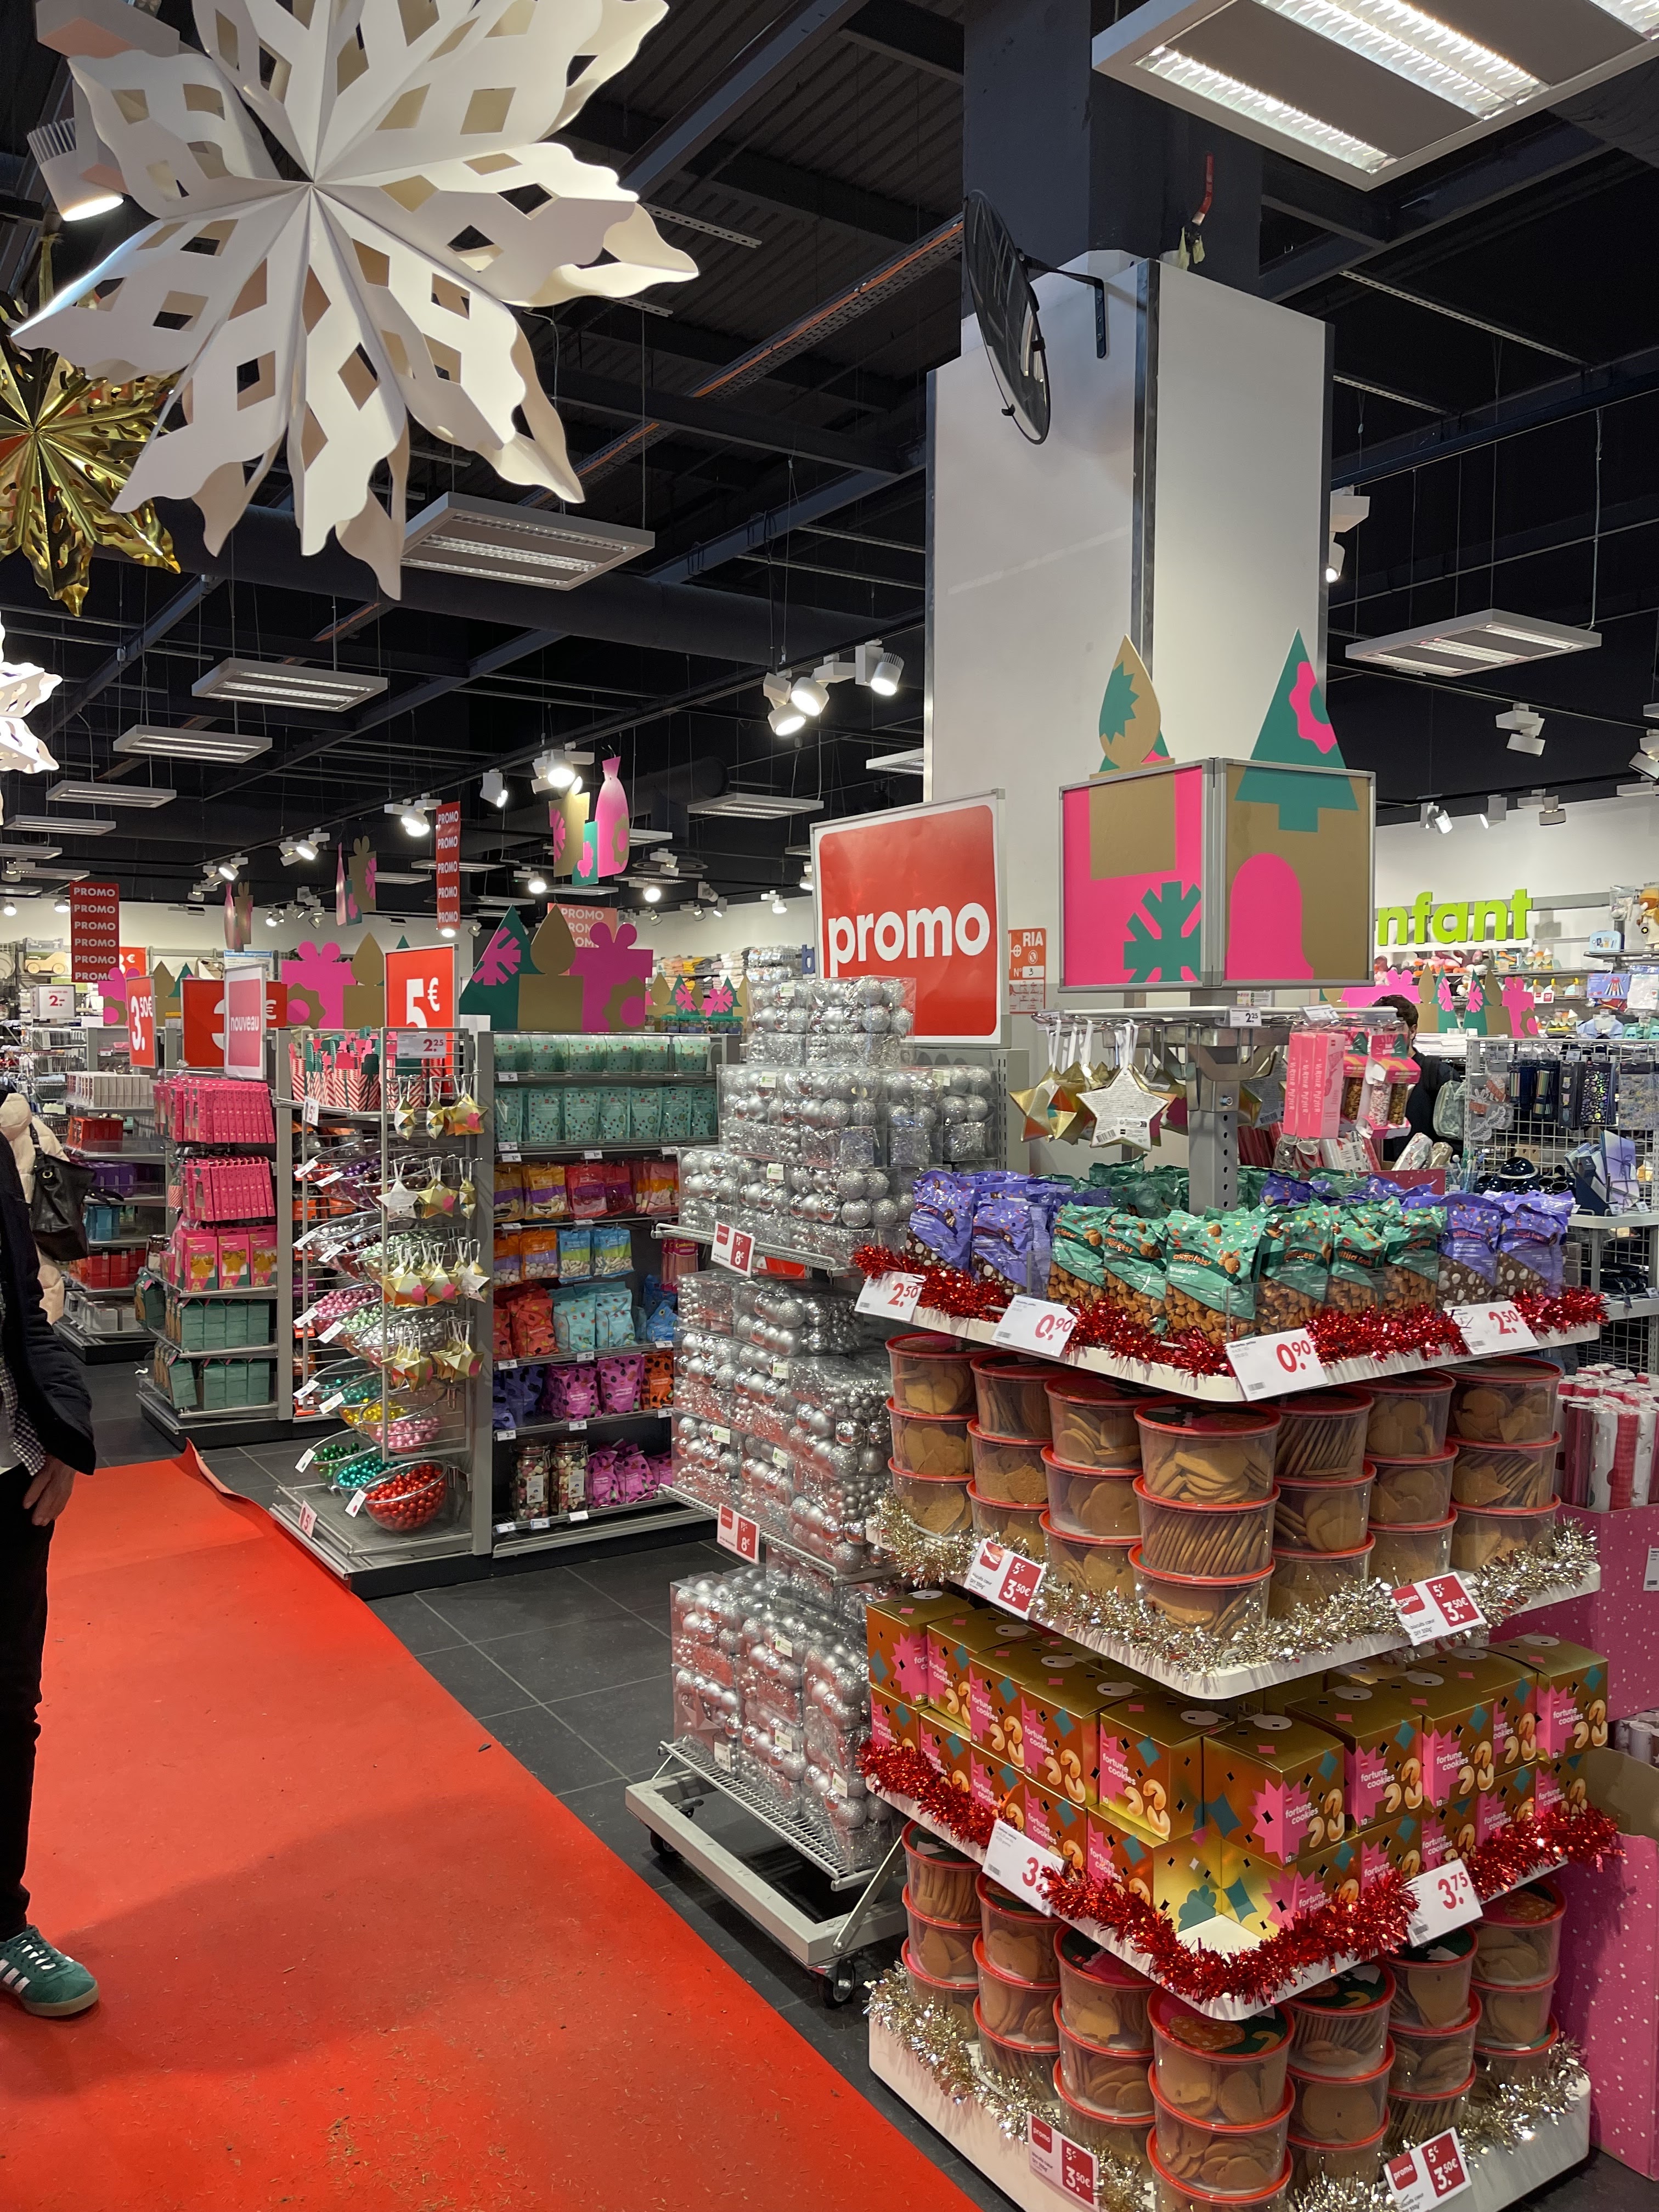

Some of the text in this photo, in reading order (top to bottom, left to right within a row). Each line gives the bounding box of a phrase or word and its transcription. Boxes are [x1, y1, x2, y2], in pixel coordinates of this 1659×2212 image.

[438, 810, 459, 823] PROMO
[438, 836, 458, 849] PROMO
[438, 861, 458, 874] PROMO
[74, 887, 115, 897] PROMO
[438, 886, 458, 898] PROMO
[74, 904, 115, 913] PROMO
[439, 911, 458, 923] PROMO
[561, 908, 603, 920] PROMO
[74, 921, 116, 931] PROMO
[1378, 889, 1532, 946] nfant
[75, 938, 116, 947] PROMO
[828, 902, 990, 977] promo
[1023, 931, 1043, 947] RIA
[75, 955, 116, 964] PROMO
[75, 972, 112, 980] PROM
[406, 977, 440, 1032] 5€
[230, 1016, 259, 1032] nouveau
[423, 1039, 444, 1052] 2.25
[887, 1283, 918, 1307] 2.50
[1035, 1314, 1073, 1341] 0.90
[1488, 1310, 1519, 1335] 2.50
[1276, 1340, 1311, 1373] 0.90
[1003, 1579, 1031, 1602] 3.50€
[1442, 1597, 1469, 1622] 3.50€
[929, 1660, 948, 1677] fortune
[933, 1671, 953, 1688] cookies
[972, 1694, 992, 1711] fortune
[976, 1706, 999, 1723] cookies
[1553, 1707, 1578, 1719] fortune
[1558, 1713, 1583, 1726] cookies
[873, 1718, 891, 1735] fortune
[1024, 1725, 1047, 1743] fortune
[878, 1729, 898, 1744] cookies
[1030, 1737, 1054, 1755] cookies
[1103, 1753, 1128, 1773] fortune
[1436, 1751, 1463, 1765] fortune
[1442, 1757, 1469, 1771] cookies
[1108, 1766, 1136, 1786] cookies
[1361, 1768, 1388, 1782] fortune
[1367, 1774, 1395, 1789] cookies
[973, 1779, 994, 1796] fortune
[1538, 1788, 1561, 1801] fortune
[1543, 1793, 1565, 1807] cookies
[1285, 1802, 1312, 1819] fortune
[1291, 1807, 1319, 1825] cookies
[1484, 1811, 1506, 1825] fortune
[1028, 1812, 1050, 1833] fortune
[1488, 1816, 1512, 1830] cookies
[1032, 1825, 1057, 1845] cookies
[1422, 1835, 1447, 1849] fortune
[1427, 1840, 1453, 1855] cookies
[1090, 1848, 1115, 1870] fortune
[1095, 1861, 1122, 1882] cookies
[1364, 1862, 1390, 1877] fortune
[1438, 1872, 1468, 1909] 3.75
[1299, 1891, 1326, 1908] fortune
[1033, 2127, 1051, 2143] promo
[1427, 2145, 1439, 2163] 5€
[1065, 2165, 1091, 2193] 3.50€
[1393, 2164, 1413, 2181] promo
[1434, 2158, 1458, 2190] 3.50€
